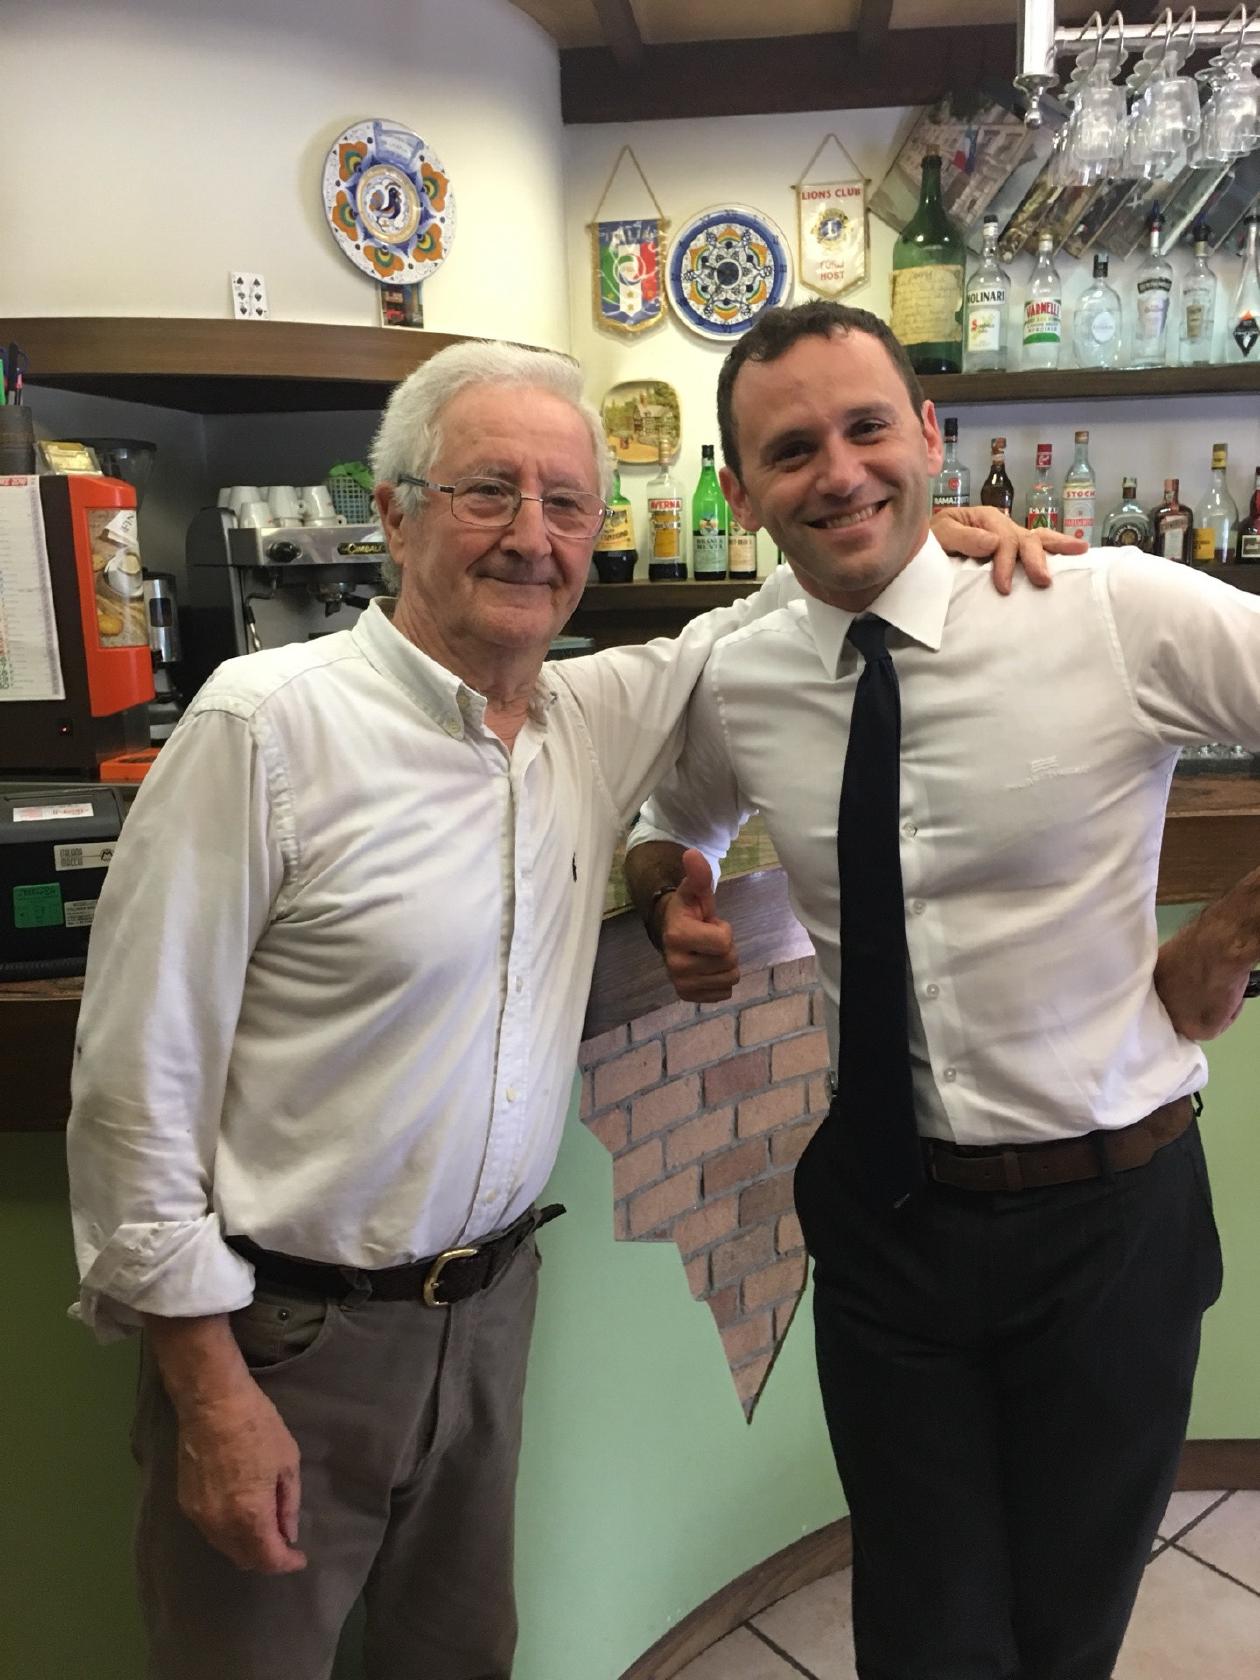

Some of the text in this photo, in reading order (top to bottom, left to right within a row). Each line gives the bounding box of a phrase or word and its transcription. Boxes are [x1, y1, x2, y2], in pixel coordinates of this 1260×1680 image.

[802, 188, 861, 201] LIONS CLUB
[820, 271, 844, 281] HOST
